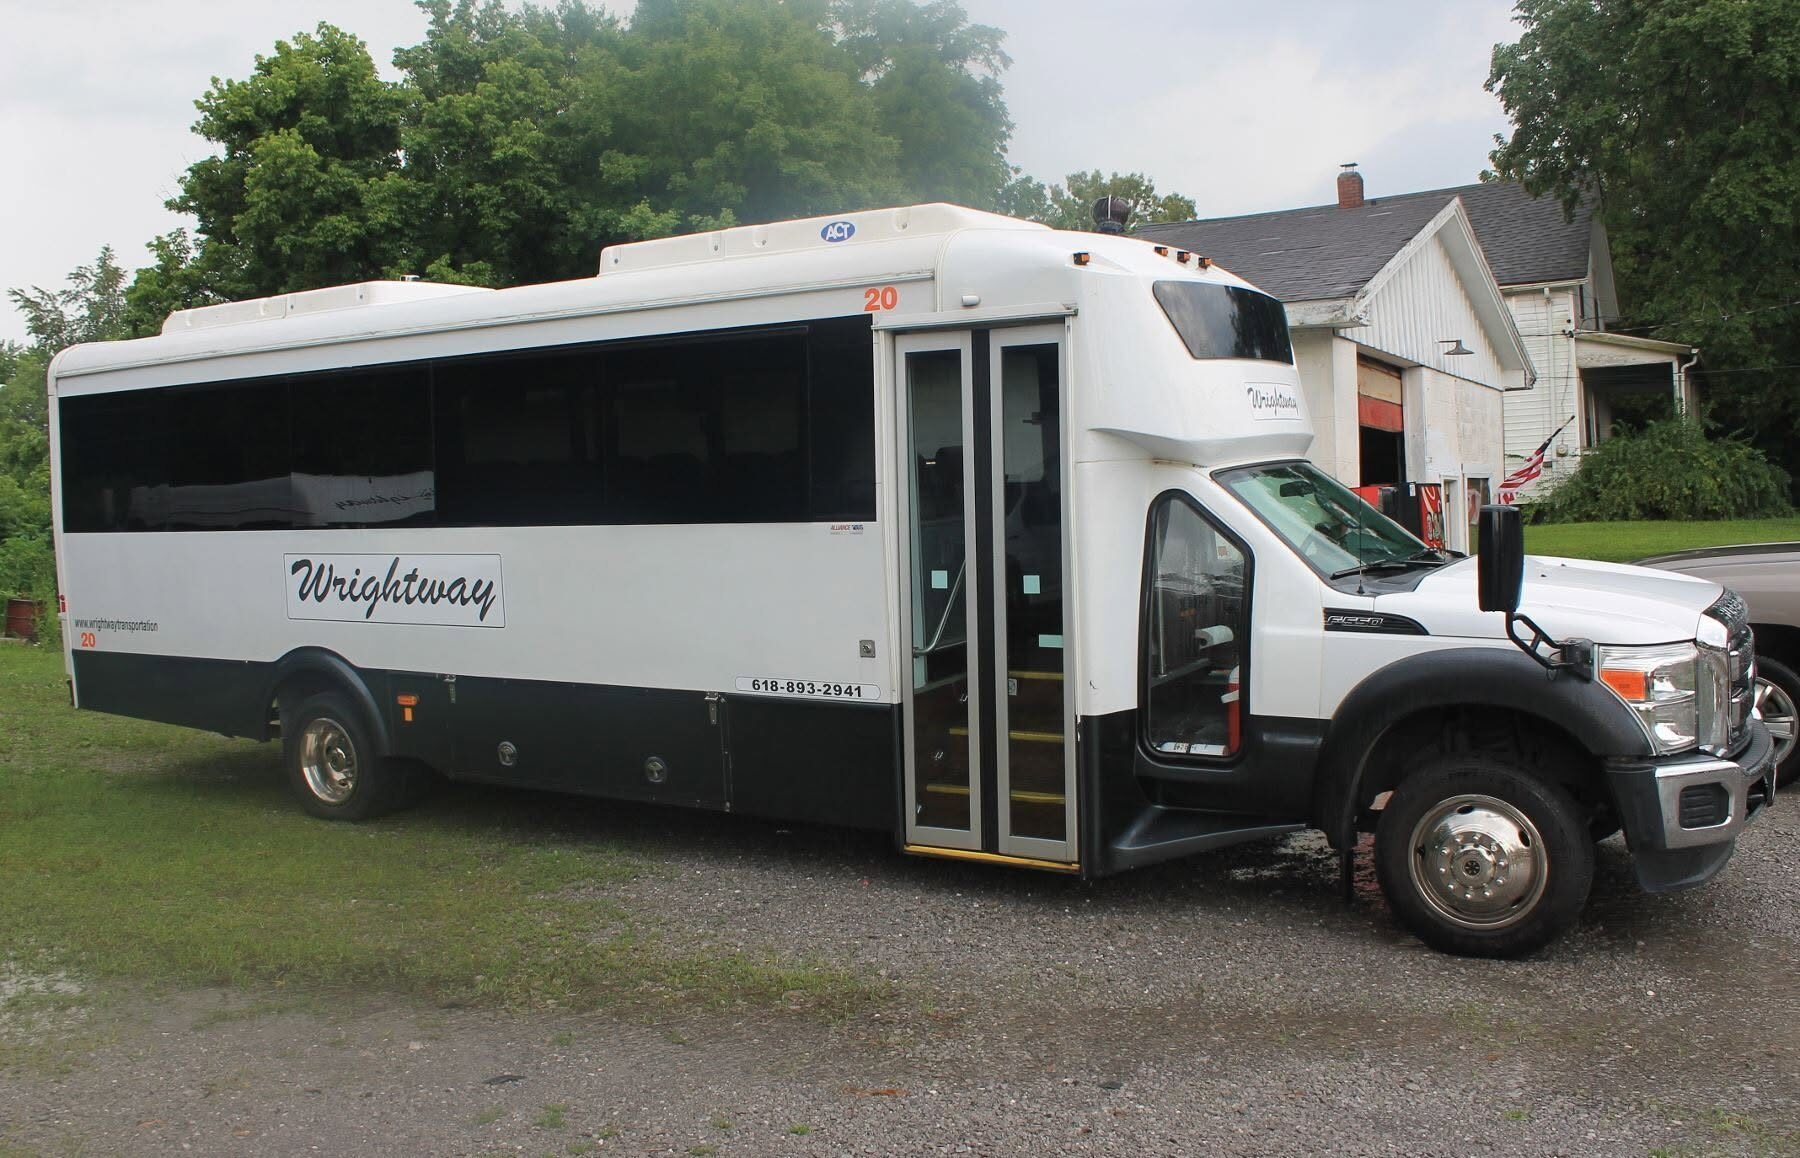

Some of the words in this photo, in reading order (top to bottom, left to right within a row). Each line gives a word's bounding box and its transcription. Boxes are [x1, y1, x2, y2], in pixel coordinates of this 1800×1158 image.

[826, 223, 850, 240] ACT
[864, 287, 898, 312] 20
[1247, 386, 1299, 417] Wrightway
[291, 556, 496, 622] Wrightway
[74, 617, 159, 633] www.wrightwaytransportation
[81, 632, 96, 647] 20
[752, 679, 862, 698] 618-893-2941
